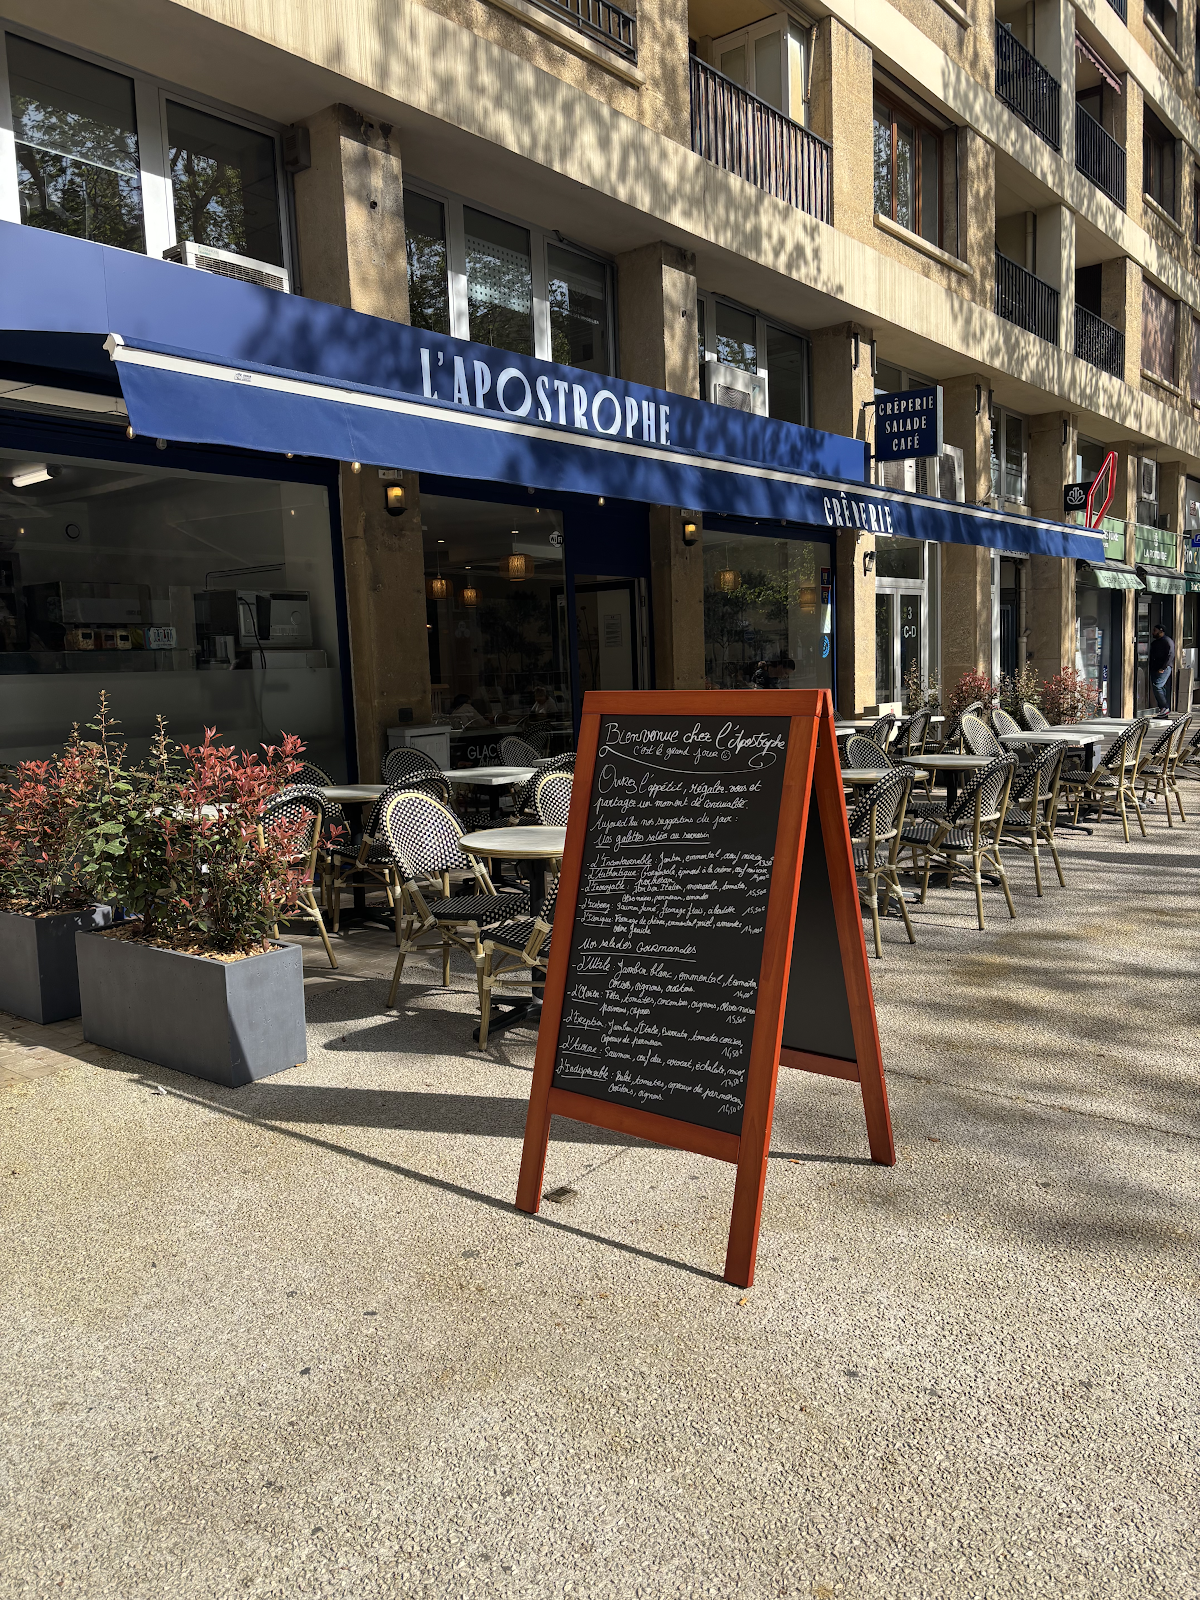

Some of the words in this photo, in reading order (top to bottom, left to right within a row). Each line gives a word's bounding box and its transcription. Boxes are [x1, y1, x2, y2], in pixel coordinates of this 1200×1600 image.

[420, 347, 671, 445] L'APOSTROPHE
[878, 395, 934, 416] CRÊPERIE
[885, 416, 927, 433] SALADE
[892, 432, 920, 451] CAFÉ
[823, 491, 894, 533] CRÊPERIE
[907, 606, 912, 620] 3
[903, 625, 917, 638] C-D
[605, 723, 679, 744] Bienvenue
[683, 723, 712, 743] chez
[633, 744, 656, 755] c'est
[656, 743, 664, 755] le
[664, 746, 690, 760] grand
[693, 745, 718, 765] jour
[599, 764, 637, 794] Ouvrez
[749, 780, 762, 791] et
[593, 797, 636, 814] partagez
[637, 800, 652, 808] un
[654, 797, 688, 808] moment
[691, 797, 701, 807] de
[696, 812, 709, 823] du
[614, 830, 644, 852] galettes
